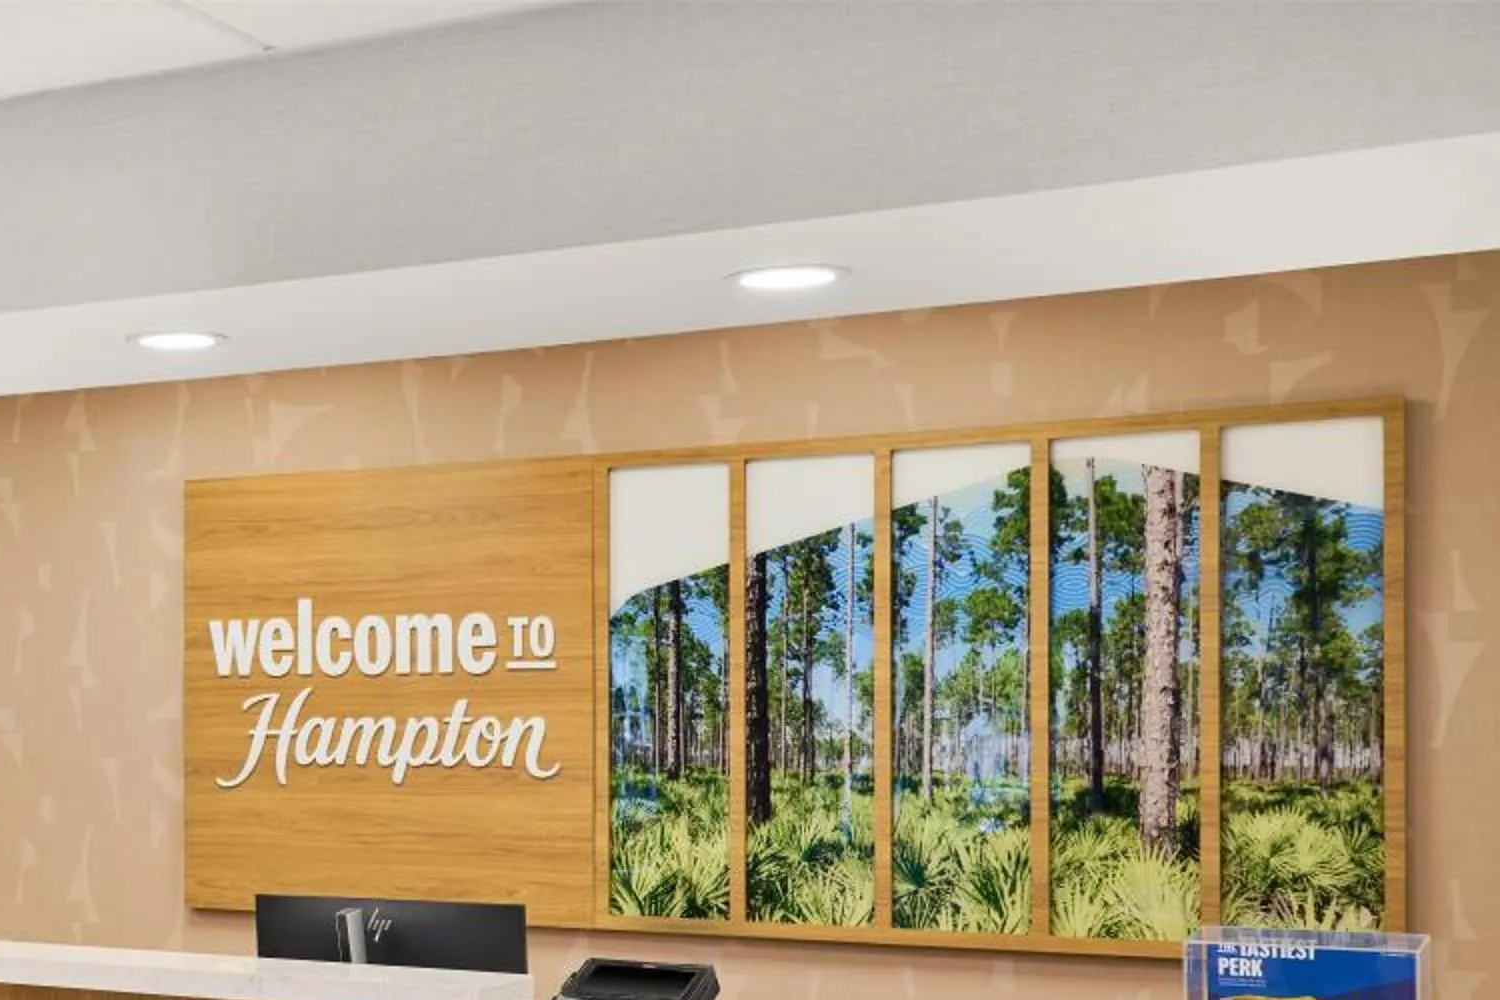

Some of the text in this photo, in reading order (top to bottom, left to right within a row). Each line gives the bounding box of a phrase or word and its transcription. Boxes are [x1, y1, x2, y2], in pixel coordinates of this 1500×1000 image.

[208, 597, 557, 677] welcome TO
[215, 687, 562, 788] Hampton
[1218, 957, 1263, 976] PERK
